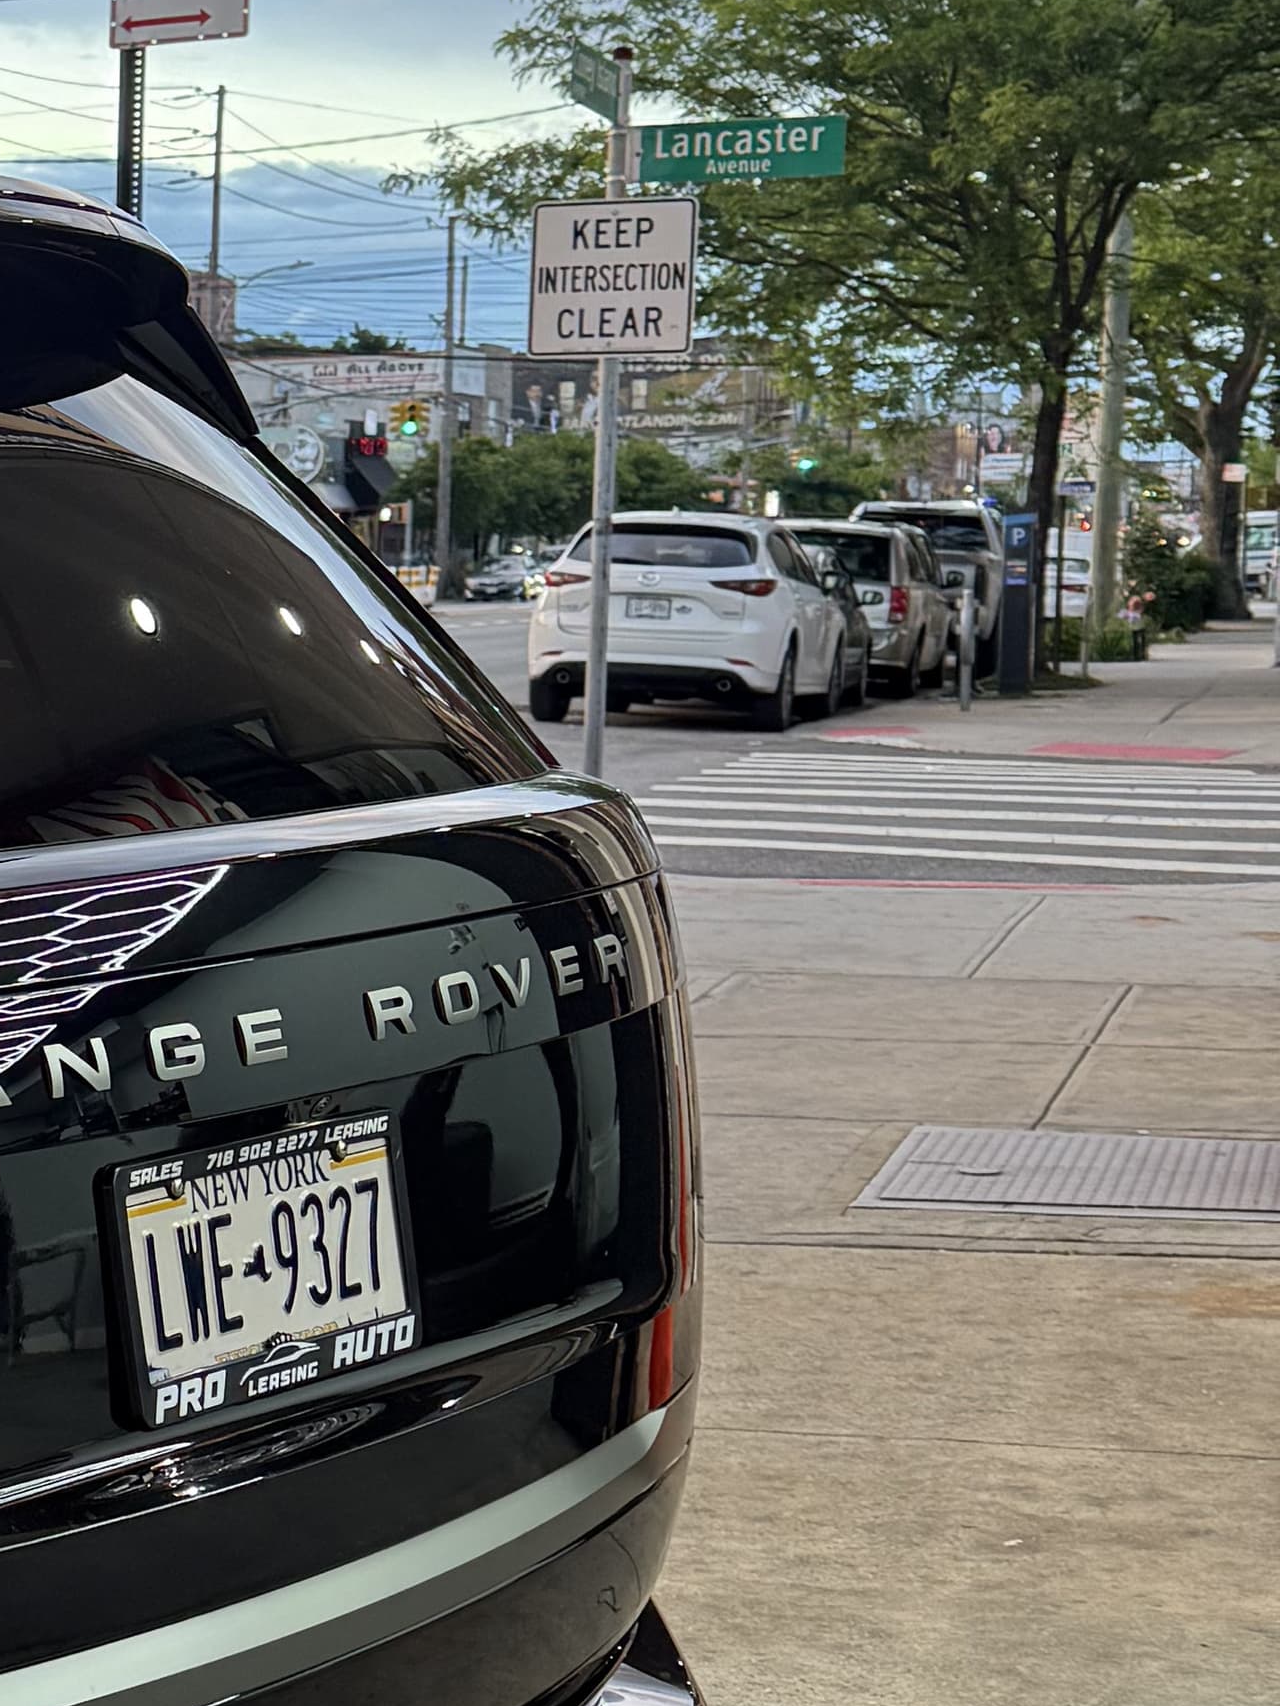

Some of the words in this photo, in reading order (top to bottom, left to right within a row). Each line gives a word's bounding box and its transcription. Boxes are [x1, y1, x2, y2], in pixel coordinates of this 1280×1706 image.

[655, 123, 826, 159] Lancaster
[705, 157, 772, 175] Avenue
[572, 217, 654, 250] KEEP
[538, 262, 686, 294] INTERSECTION
[557, 306, 663, 339] CLEAR
[364, 933, 627, 1042] ROVER
[129, 1160, 184, 1188] SALES
[206, 1148, 233, 1171] 718
[238, 1143, 271, 1163] 902
[275, 1130, 318, 1156] 2277
[324, 1115, 389, 1143] LEASING
[190, 1165, 251, 1213] NEW
[254, 1148, 331, 1197] YORK
[154, 1368, 227, 1425] PRO
[247, 1361, 319, 1397] LEASING
[333, 1314, 416, 1371] AUTO
